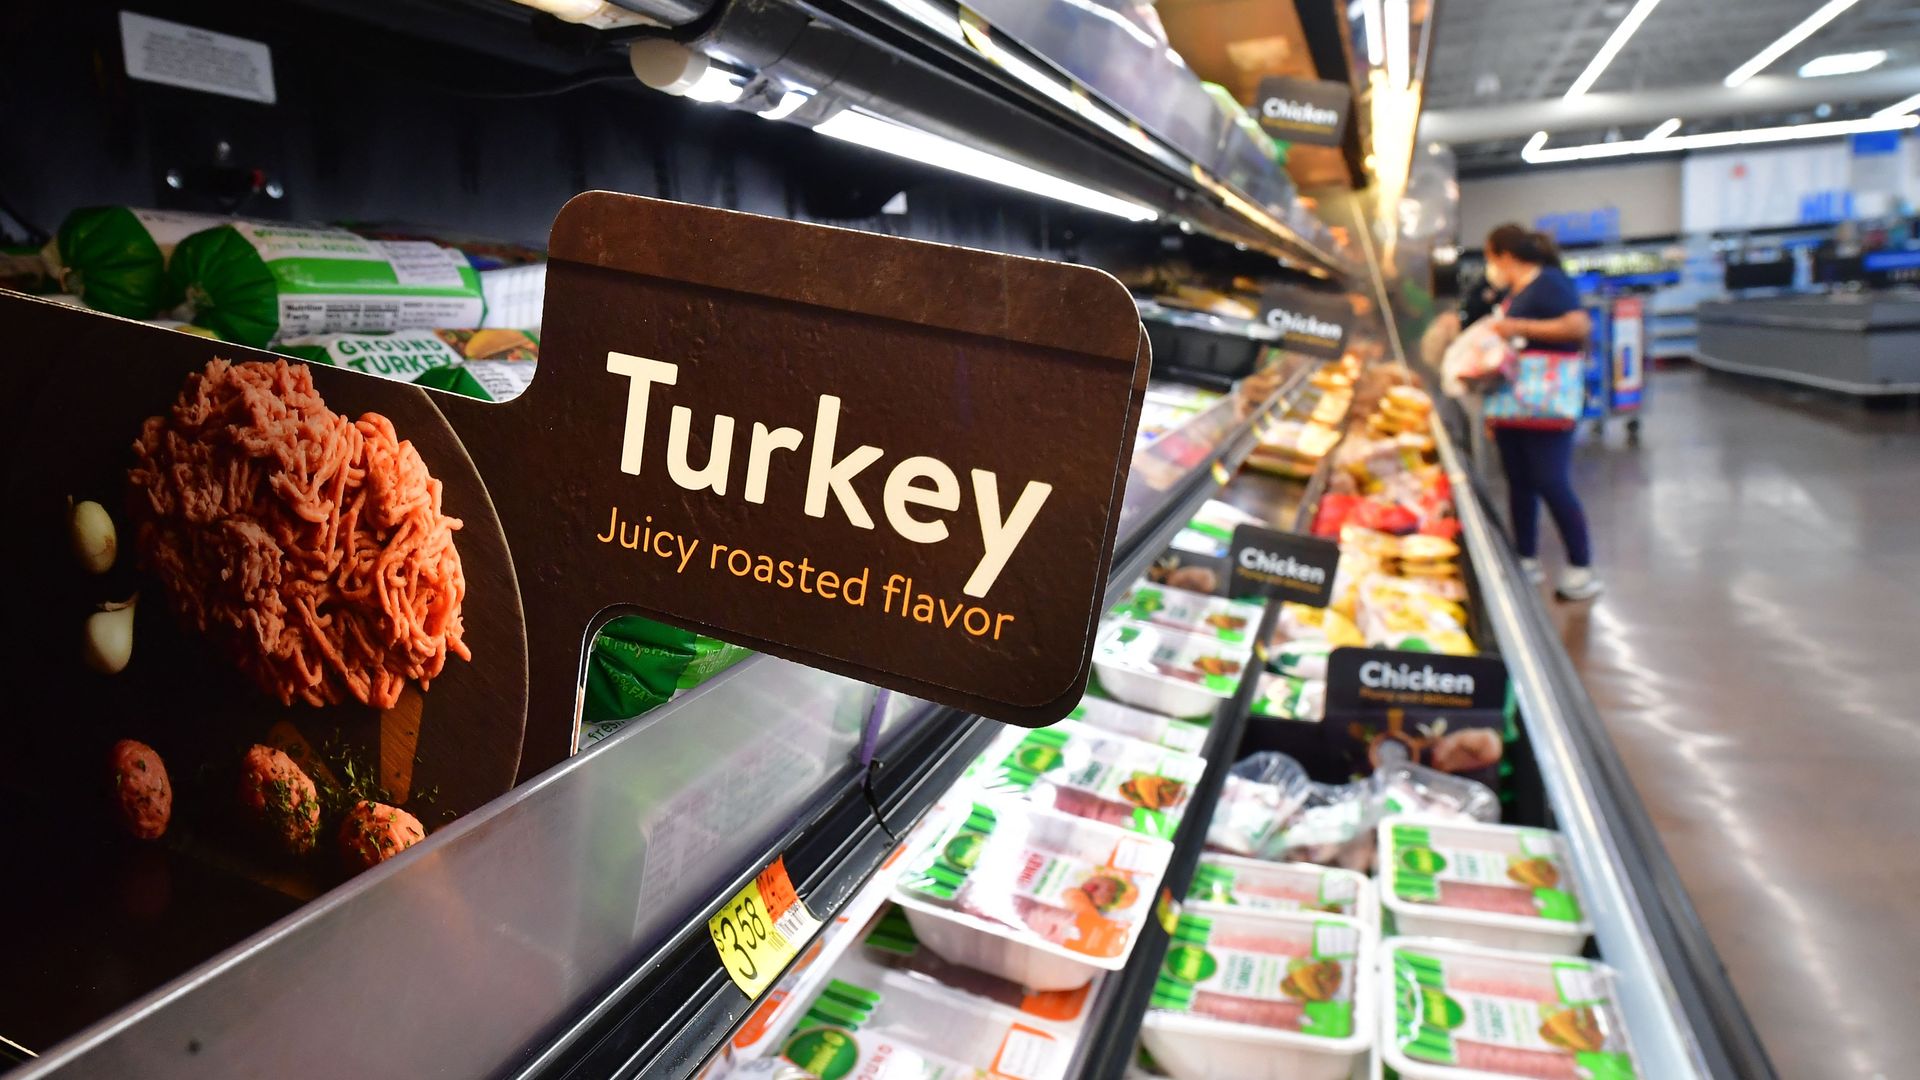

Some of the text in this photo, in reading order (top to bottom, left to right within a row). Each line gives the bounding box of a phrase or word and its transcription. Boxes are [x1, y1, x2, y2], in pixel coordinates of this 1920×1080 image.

[1263, 97, 1338, 127] Chicken
[1267, 308, 1342, 340] Chicken
[337, 338, 444, 357] GROUND
[347, 353, 453, 375] TURKEY
[606, 351, 1053, 598] Turkey
[597, 507, 1014, 640] Juicy roasted flavor
[1239, 547, 1326, 584] Chicken
[1359, 660, 1475, 695] Chicken
